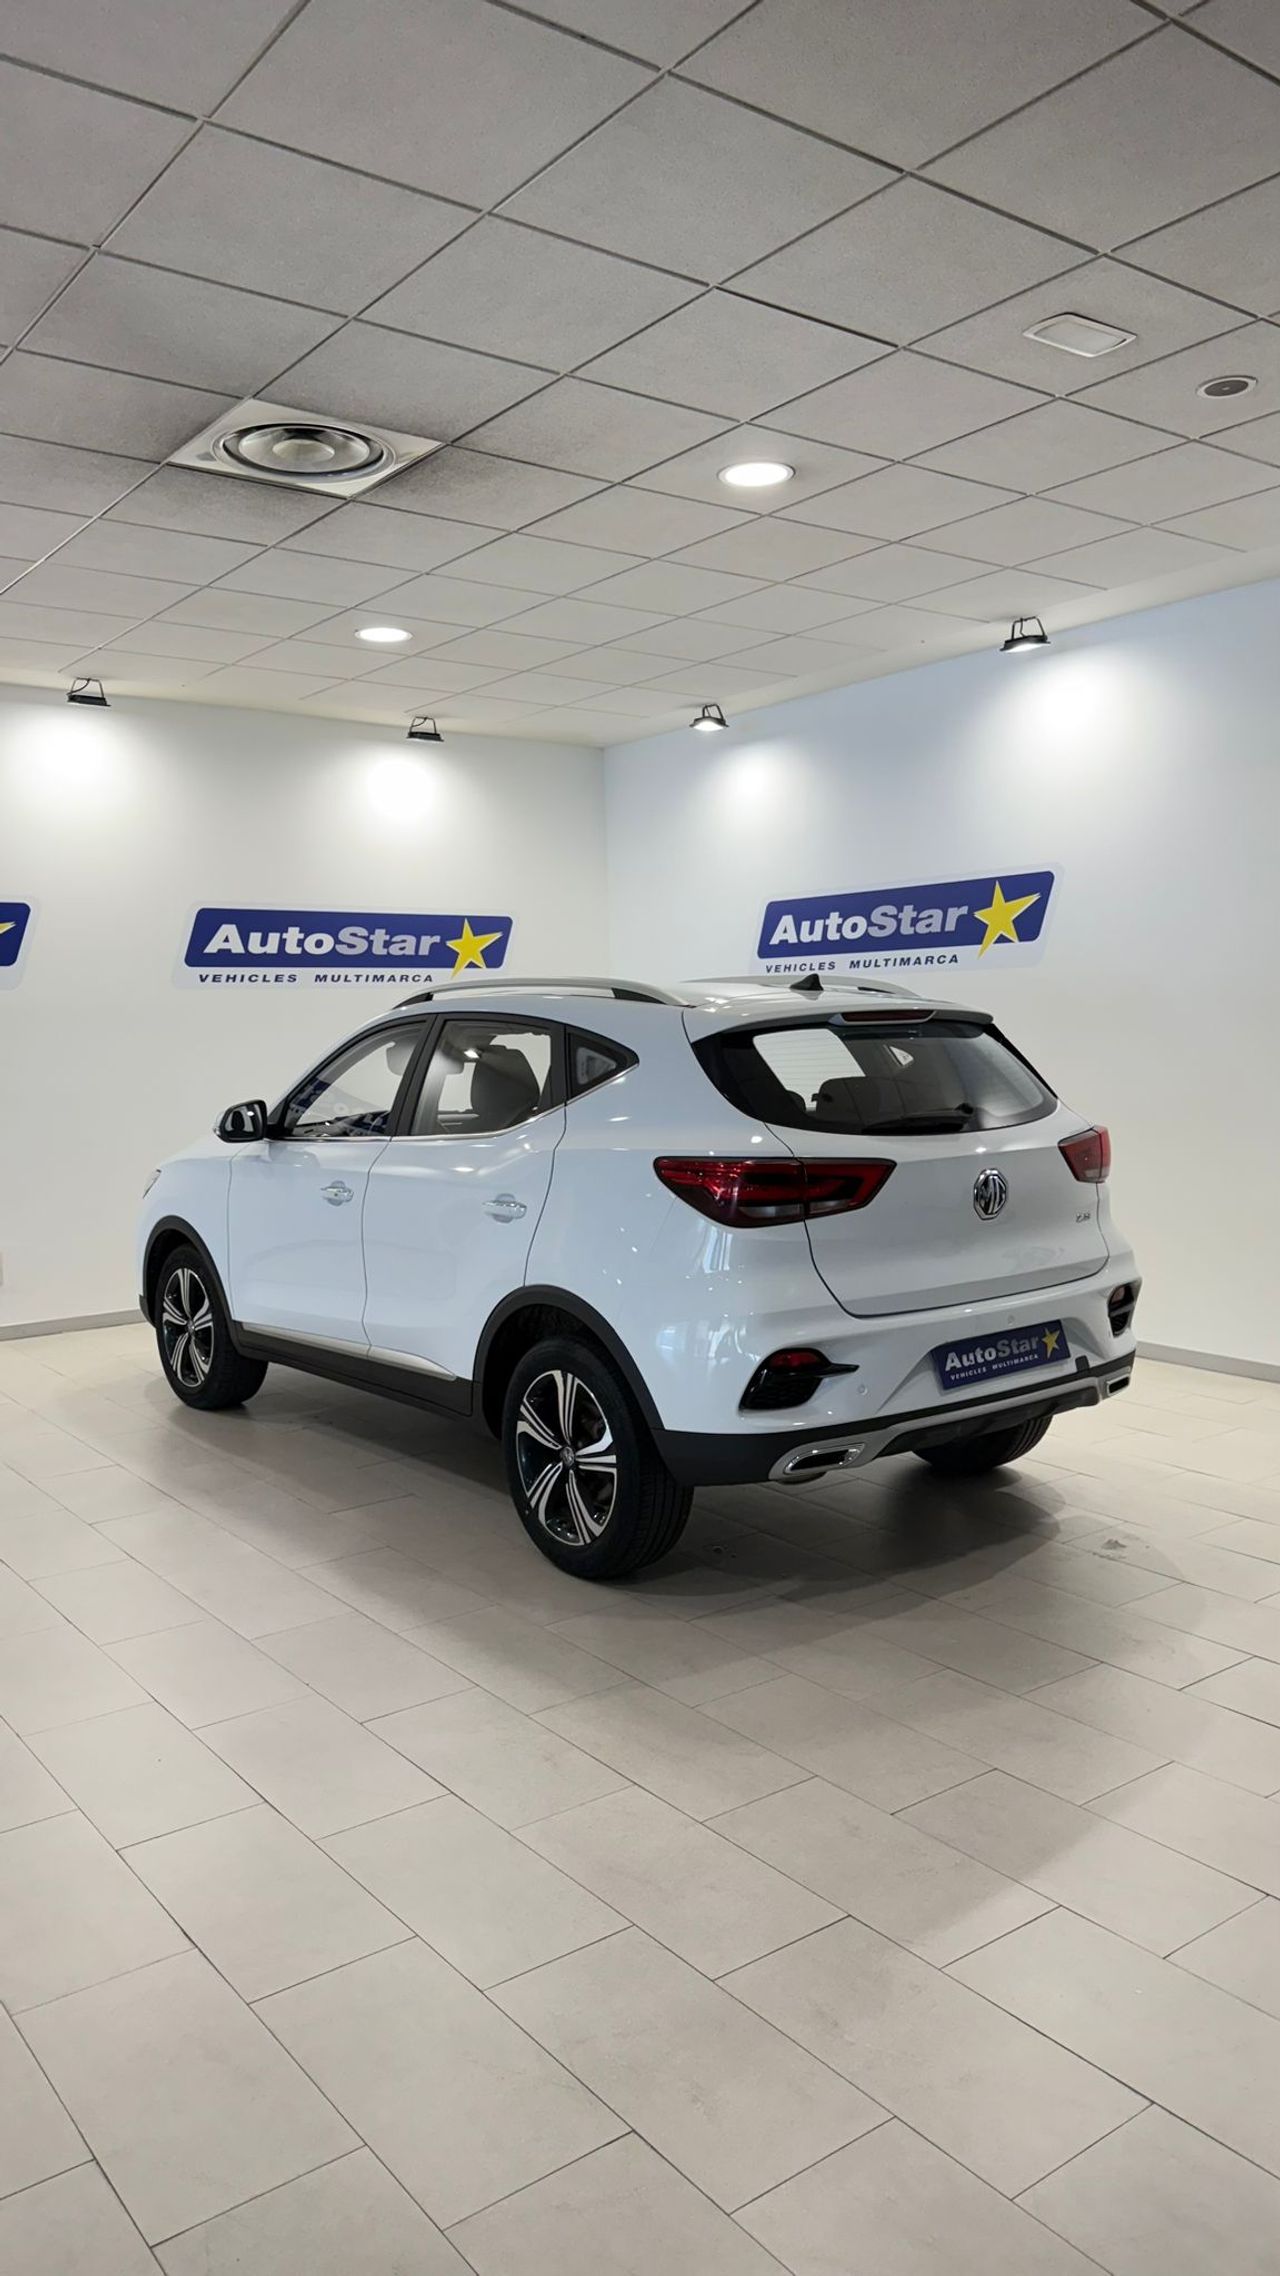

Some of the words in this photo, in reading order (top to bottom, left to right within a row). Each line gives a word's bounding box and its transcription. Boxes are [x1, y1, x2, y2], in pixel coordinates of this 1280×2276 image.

[203, 924, 441, 956] AutoStar
[768, 905, 968, 945] AutoStar
[199, 973, 298, 984] VEHICLES
[314, 973, 433, 984] MULTIMARCA
[766, 961, 836, 974] VEHICLES
[849, 954, 959, 970] MULTIMARCA
[975, 1171, 1007, 1218] MG
[944, 1335, 1039, 1372] AutoStar
[950, 1366, 987, 1381] VEHICLES
[992, 1354, 1039, 1370] MULTIMARCA
